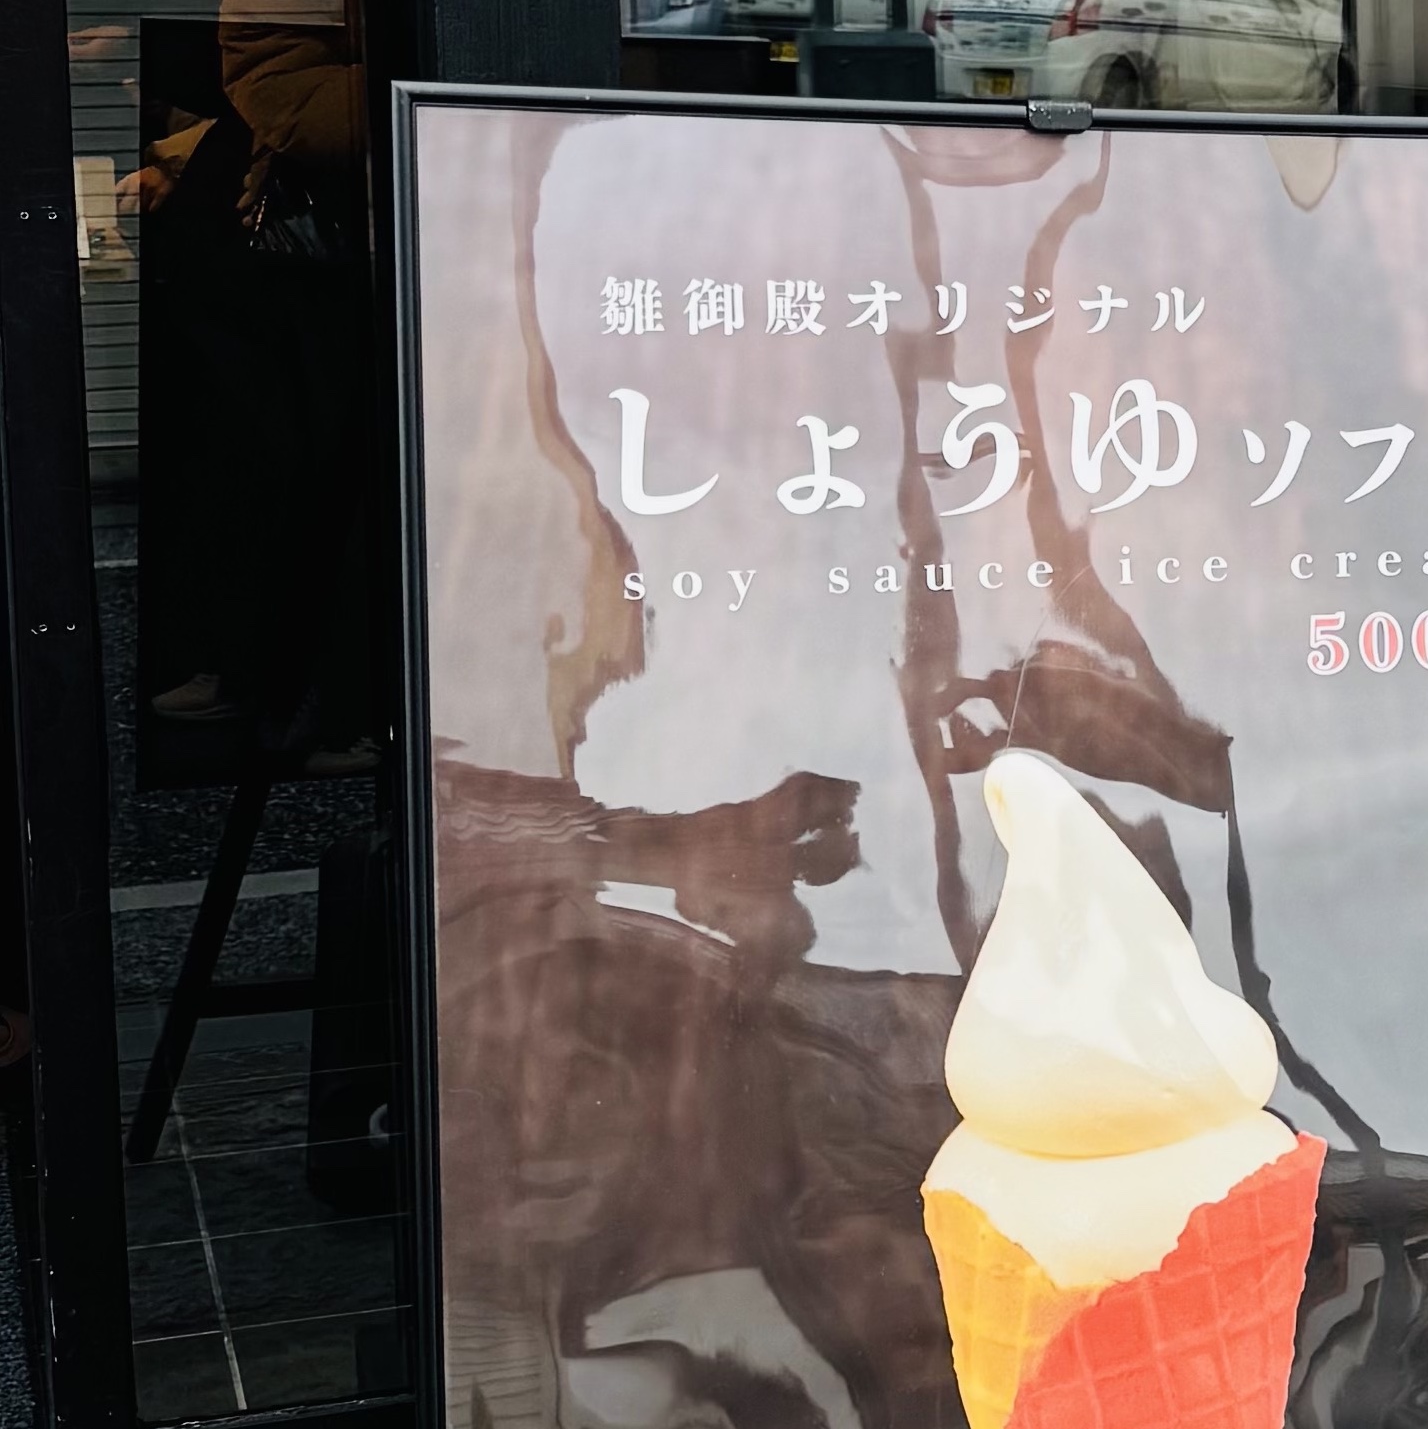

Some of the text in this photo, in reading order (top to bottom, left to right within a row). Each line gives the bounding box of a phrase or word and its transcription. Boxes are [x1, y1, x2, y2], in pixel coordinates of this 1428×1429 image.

[599, 274, 1207, 338] 雛御殿オリジナル
[622, 562, 758, 614] soy
[826, 546, 1058, 595] sauce
[1117, 542, 1229, 585] ice
